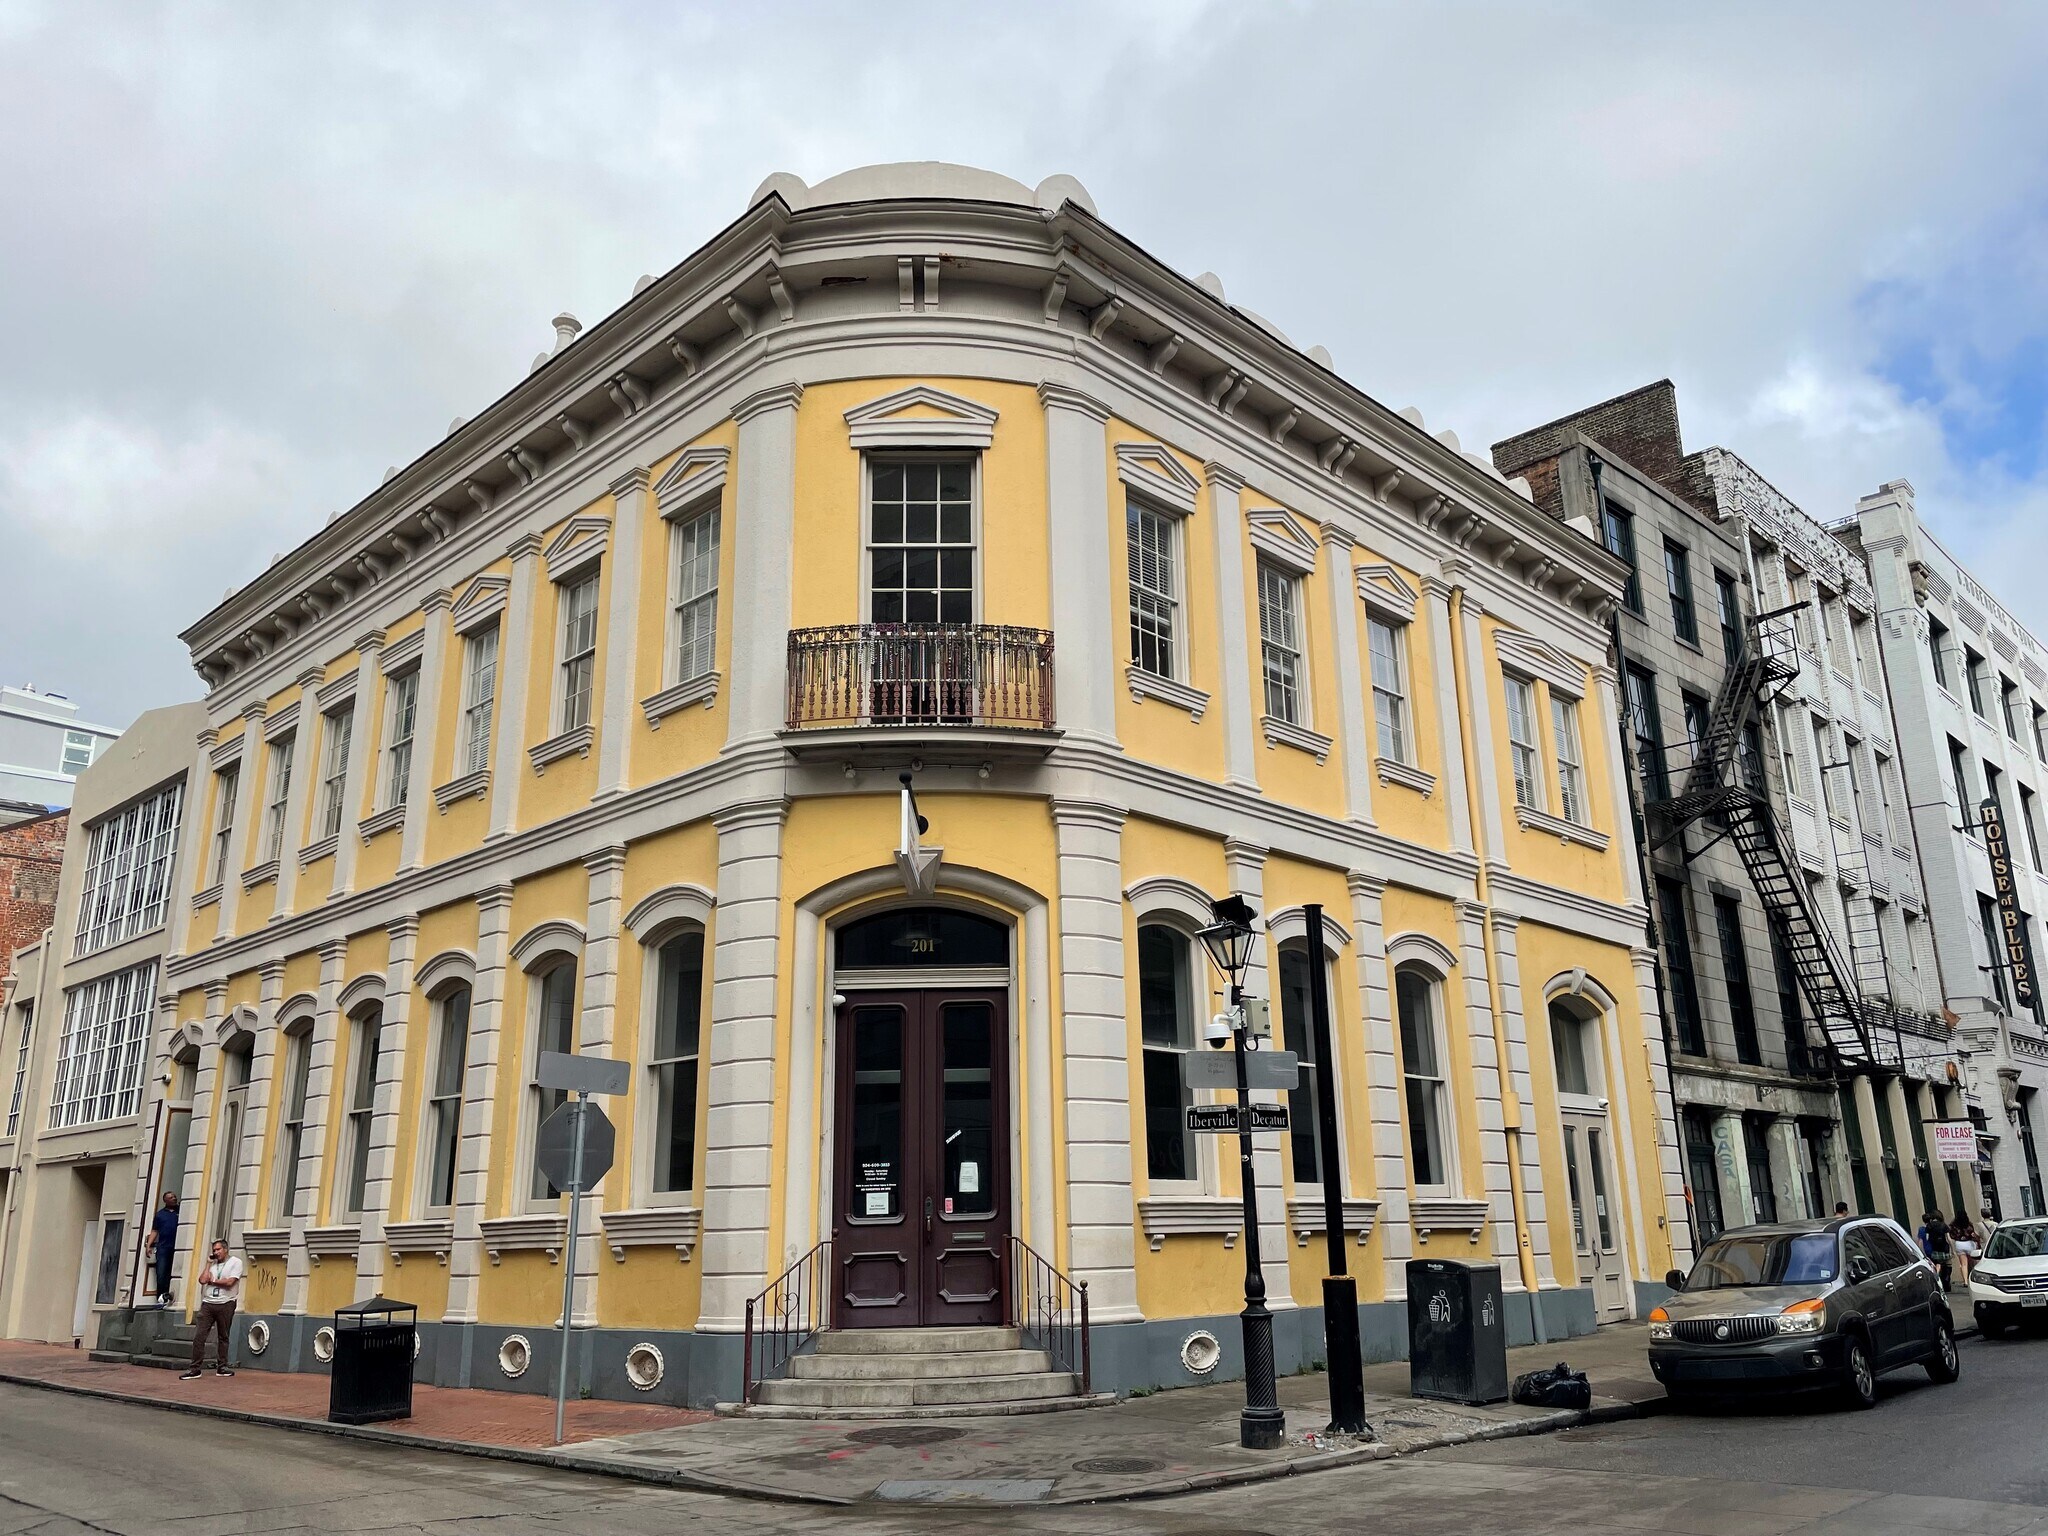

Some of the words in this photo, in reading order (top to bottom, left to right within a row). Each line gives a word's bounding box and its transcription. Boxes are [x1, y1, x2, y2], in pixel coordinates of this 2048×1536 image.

[1981, 806, 2011, 892] HOUSE
[2000, 895, 2013, 906] of
[911, 939, 935, 953] 201
[2002, 911, 2032, 998] BLUES
[1189, 1113, 1236, 1128] Iberville
[1252, 1112, 1287, 1126] Decatur
[1935, 1127, 1950, 1139] FOR
[1950, 1127, 1973, 1138] LEASE
